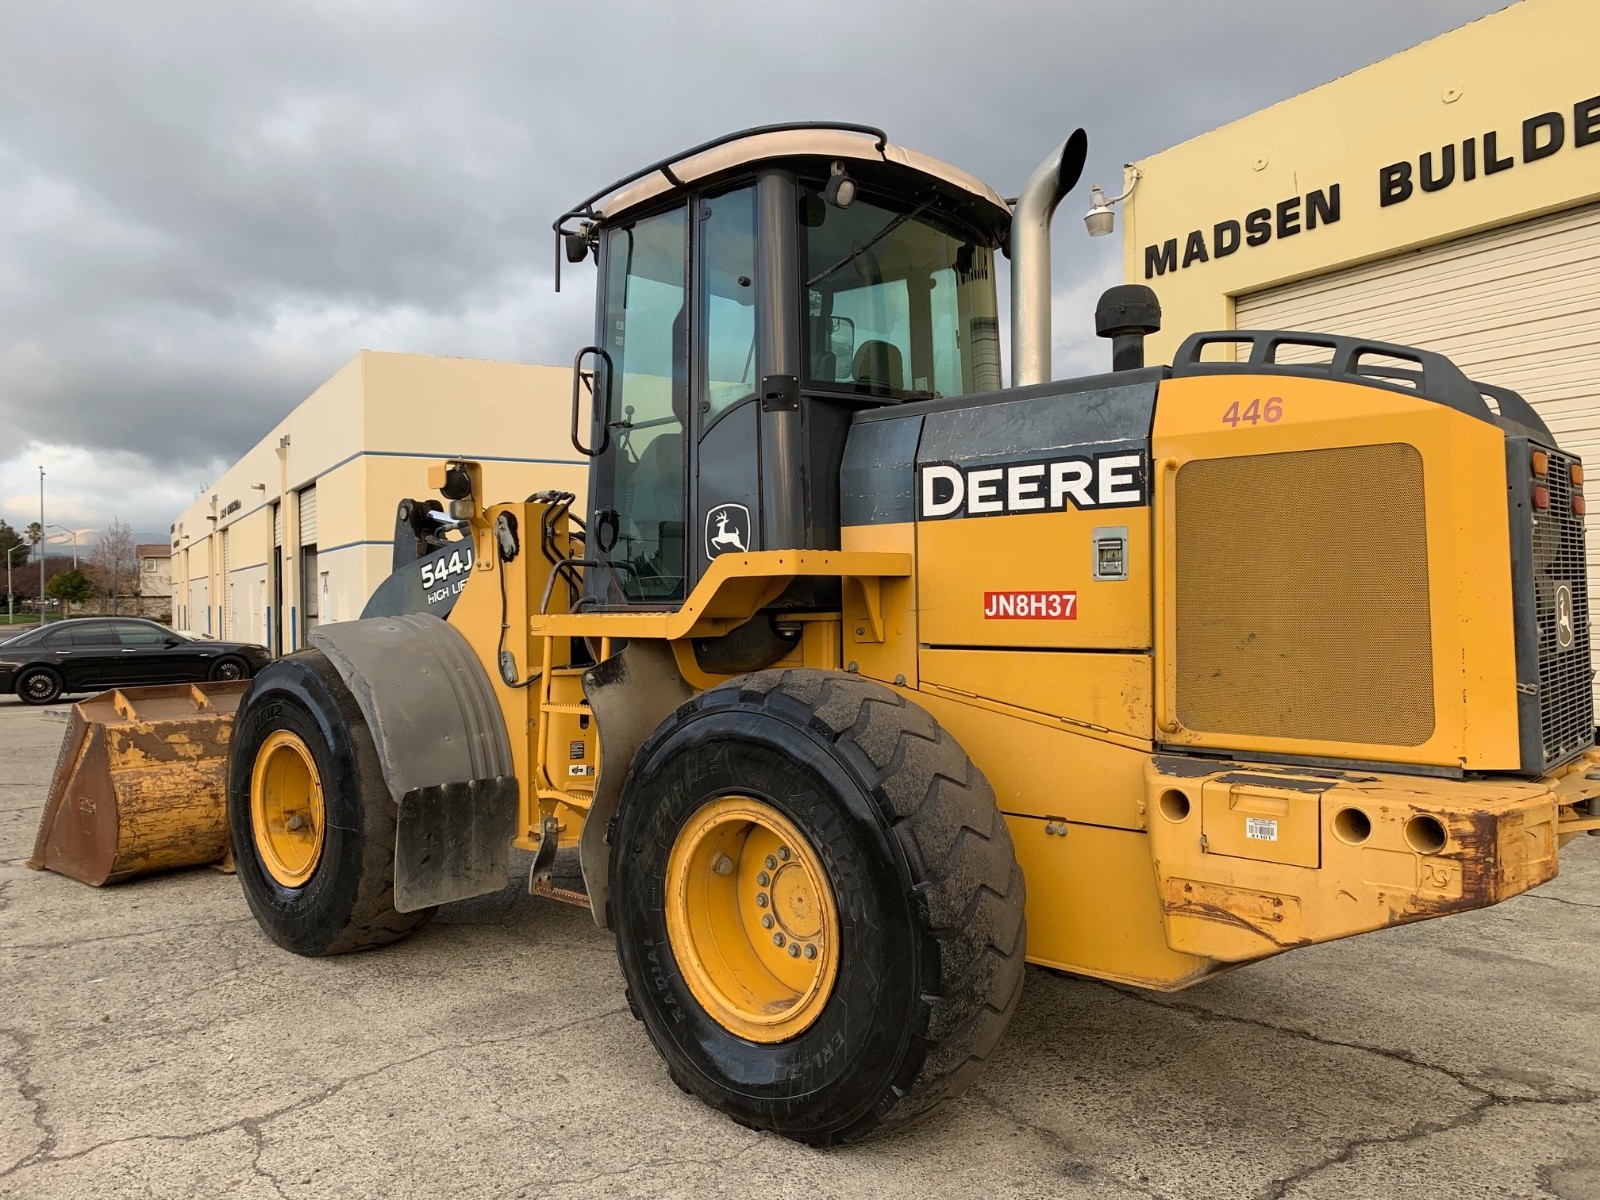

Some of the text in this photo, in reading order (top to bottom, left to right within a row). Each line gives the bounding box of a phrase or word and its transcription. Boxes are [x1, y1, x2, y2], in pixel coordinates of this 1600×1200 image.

[1145, 95, 1600, 279] MADSEN BUILDE
[1222, 397, 1283, 427] 446
[922, 455, 1141, 517] DEERE
[421, 549, 473, 589] 544J
[427, 578, 469, 605] HIGH LIF
[985, 594, 1077, 618] JN8H37
